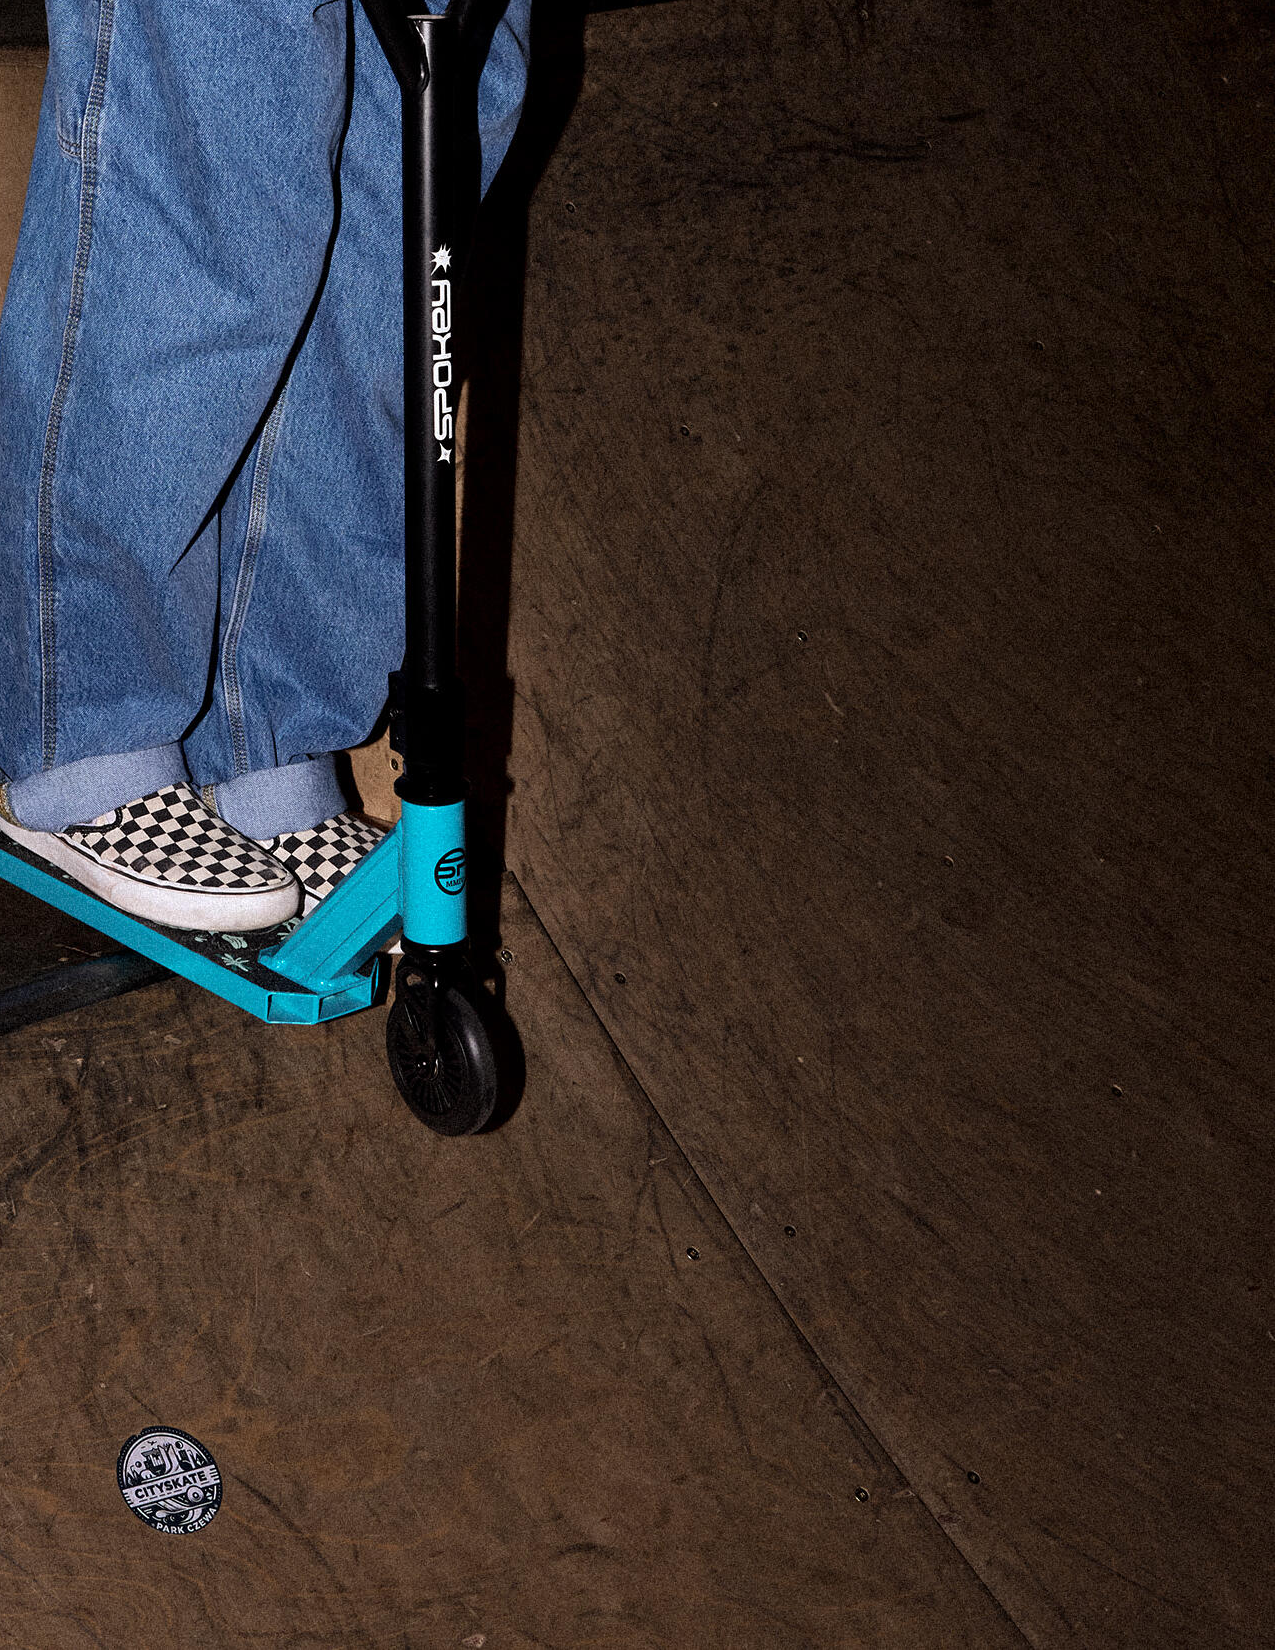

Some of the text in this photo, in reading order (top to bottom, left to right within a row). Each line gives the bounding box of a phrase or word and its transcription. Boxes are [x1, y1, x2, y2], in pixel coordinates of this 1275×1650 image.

[134, 1471, 208, 1500] CITYSKATE
[156, 1507, 218, 1534] PARK CZEWA
